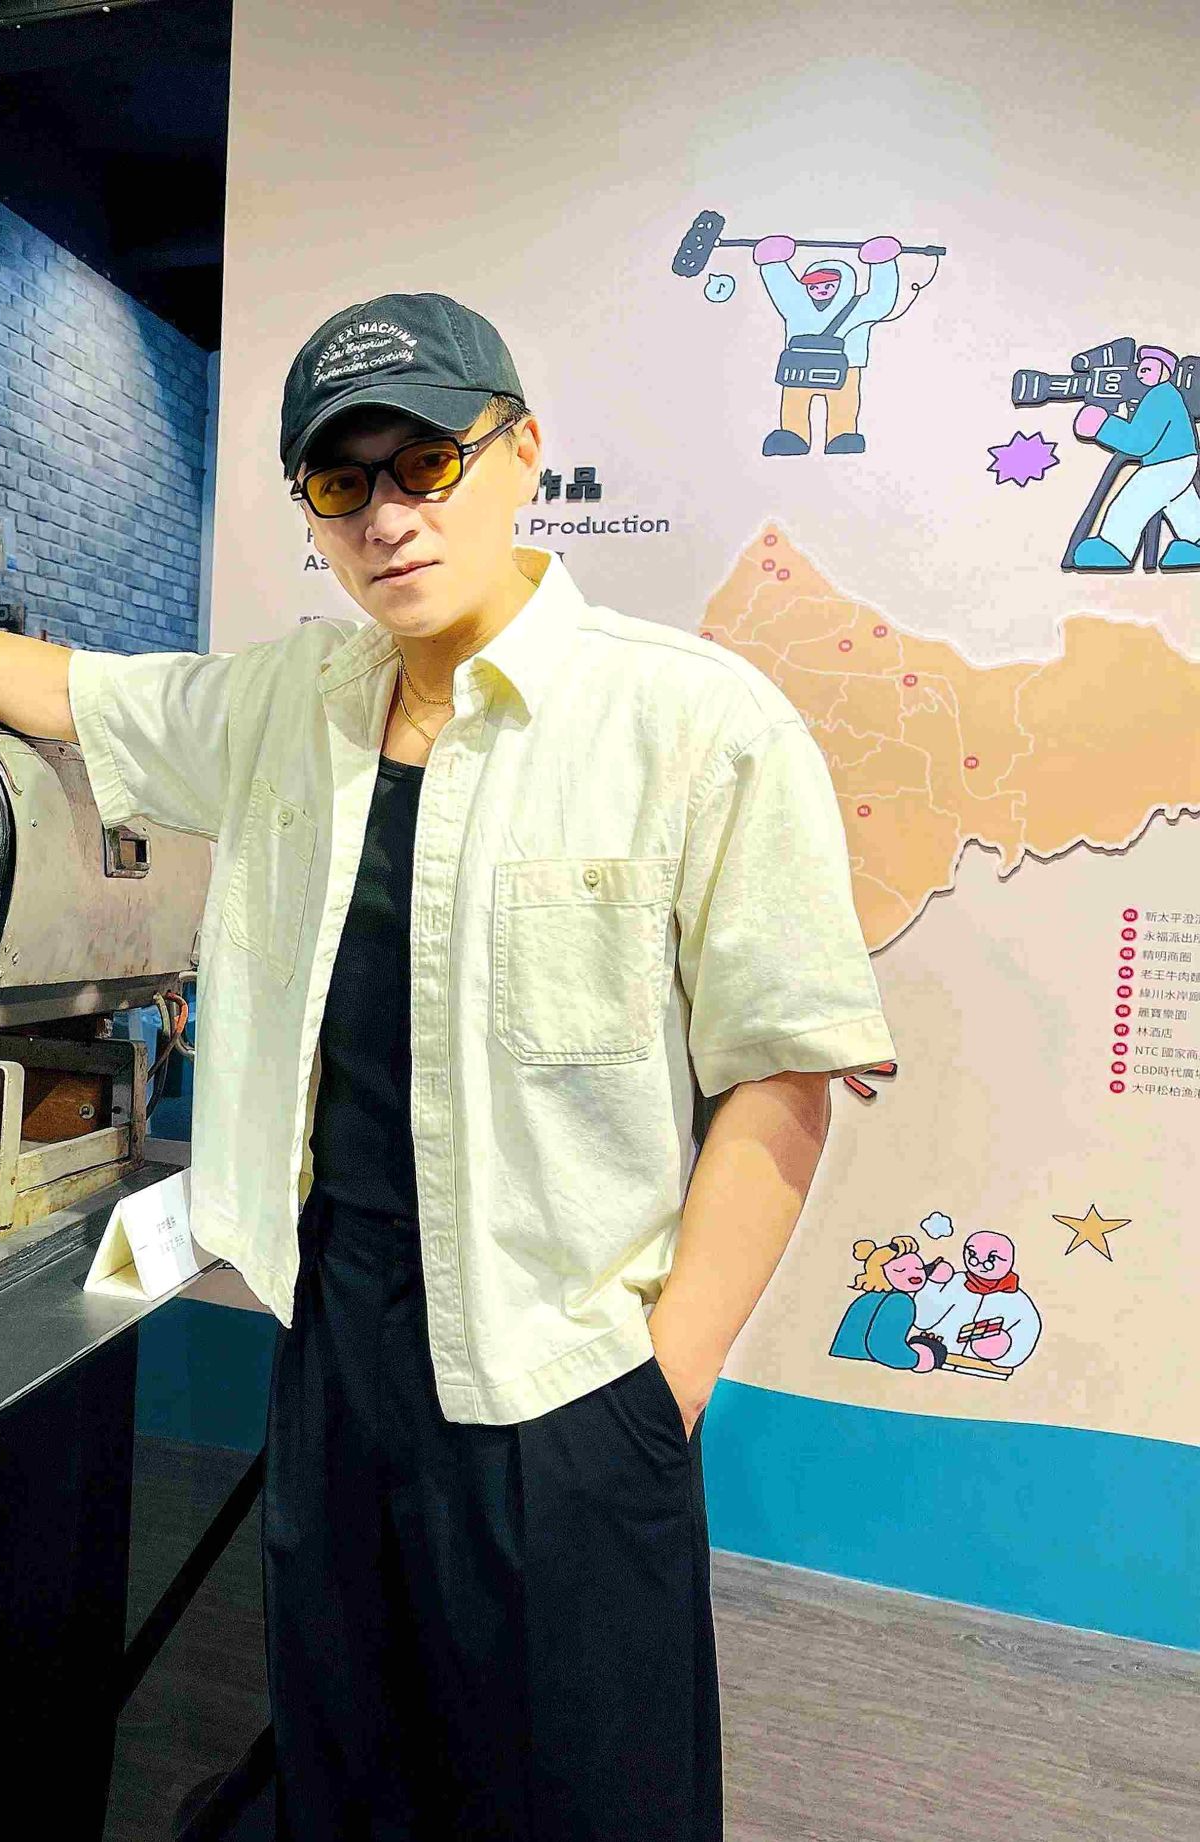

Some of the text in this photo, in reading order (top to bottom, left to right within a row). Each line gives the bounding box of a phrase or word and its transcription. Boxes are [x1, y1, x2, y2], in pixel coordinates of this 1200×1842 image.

[314, 321, 418, 376] DEUS EX MACHINA
[530, 515, 670, 536] Production
[1135, 1046, 1159, 1056] NTC
[1161, 1047, 1200, 1060] 國家商
